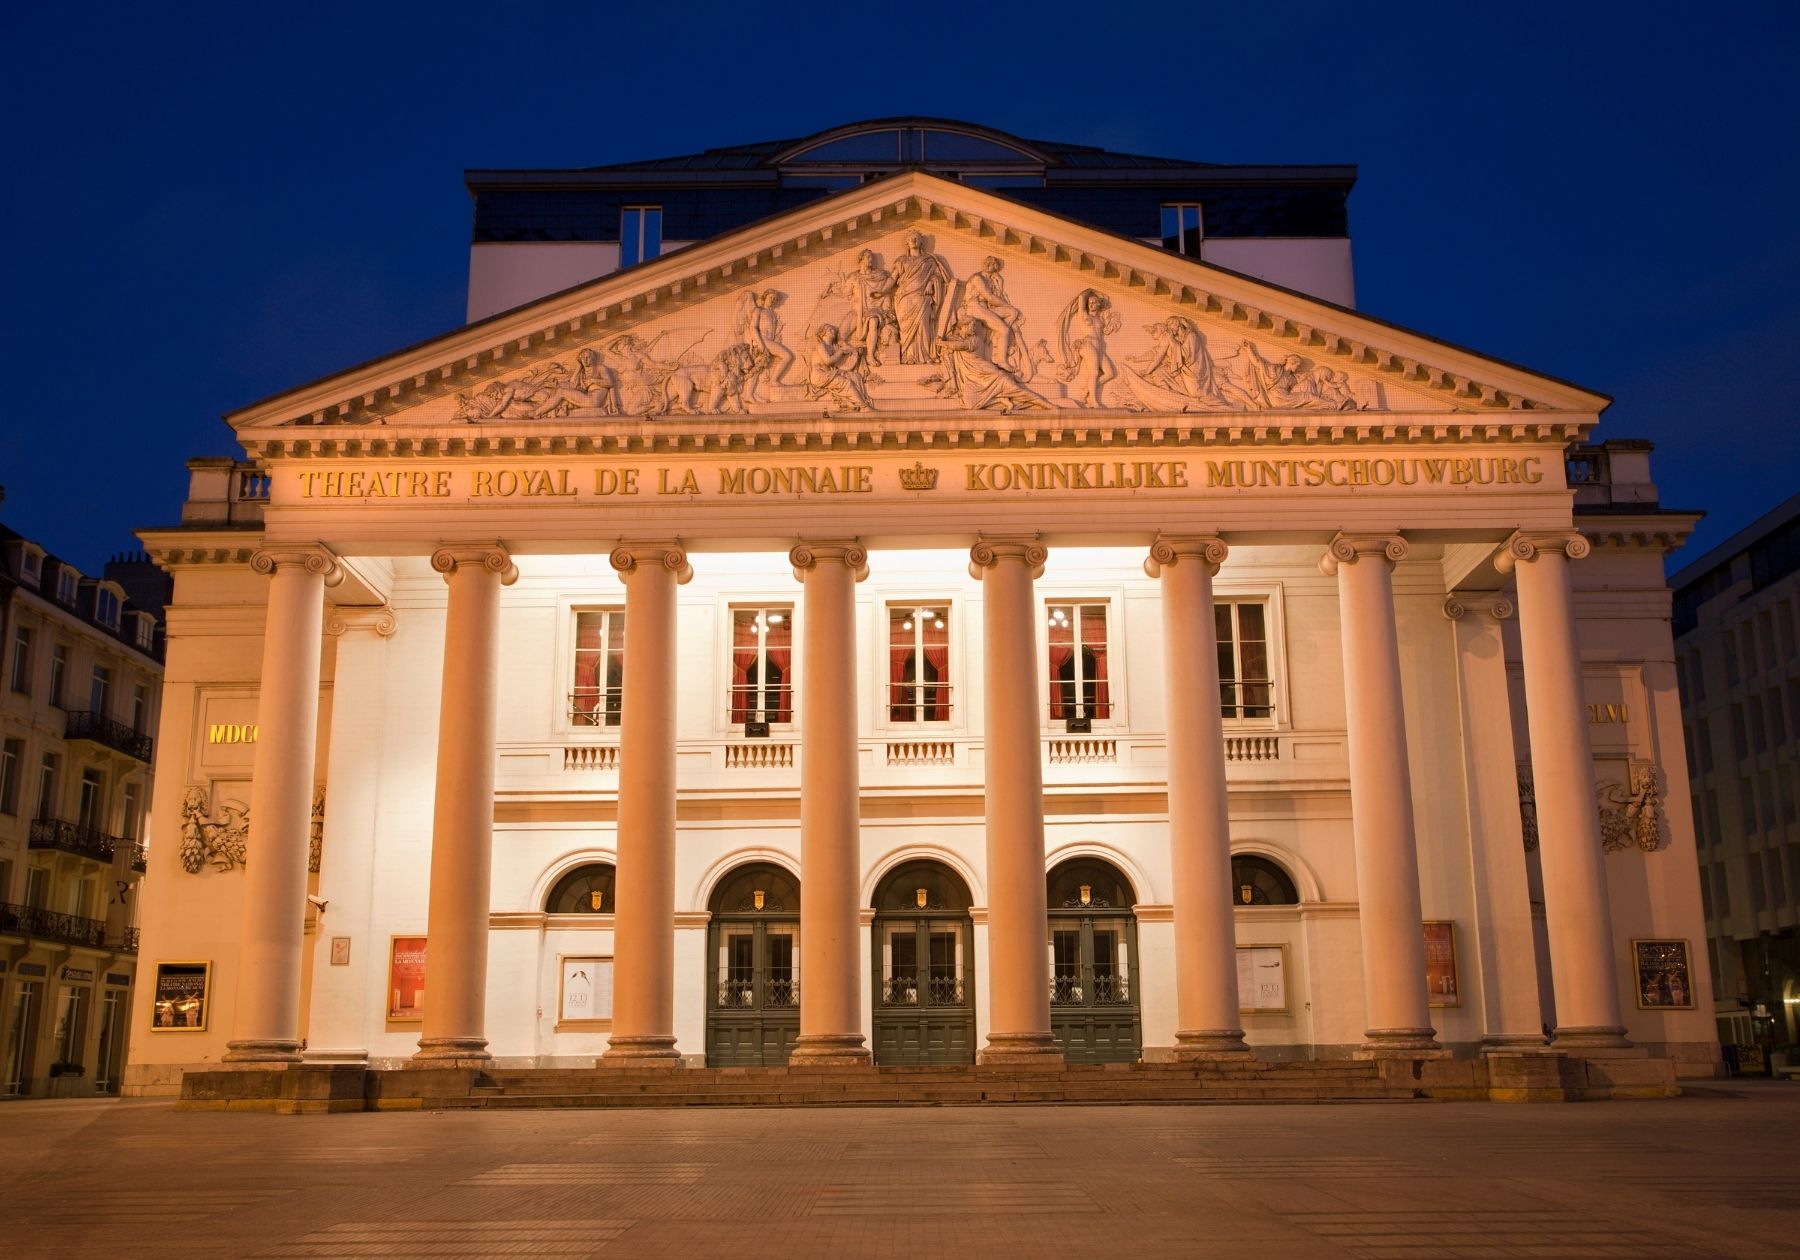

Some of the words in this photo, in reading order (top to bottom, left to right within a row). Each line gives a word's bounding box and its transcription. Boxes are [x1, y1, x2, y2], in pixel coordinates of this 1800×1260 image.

[299, 470, 452, 498] THEATRE
[471, 469, 579, 497] ROYAL
[594, 468, 640, 495] DE
[657, 468, 702, 495] LA
[718, 466, 873, 494] MONNAIE
[965, 461, 1189, 491] KONINKLIJKE
[1205, 456, 1544, 487] MUNTSCHOUWBURG
